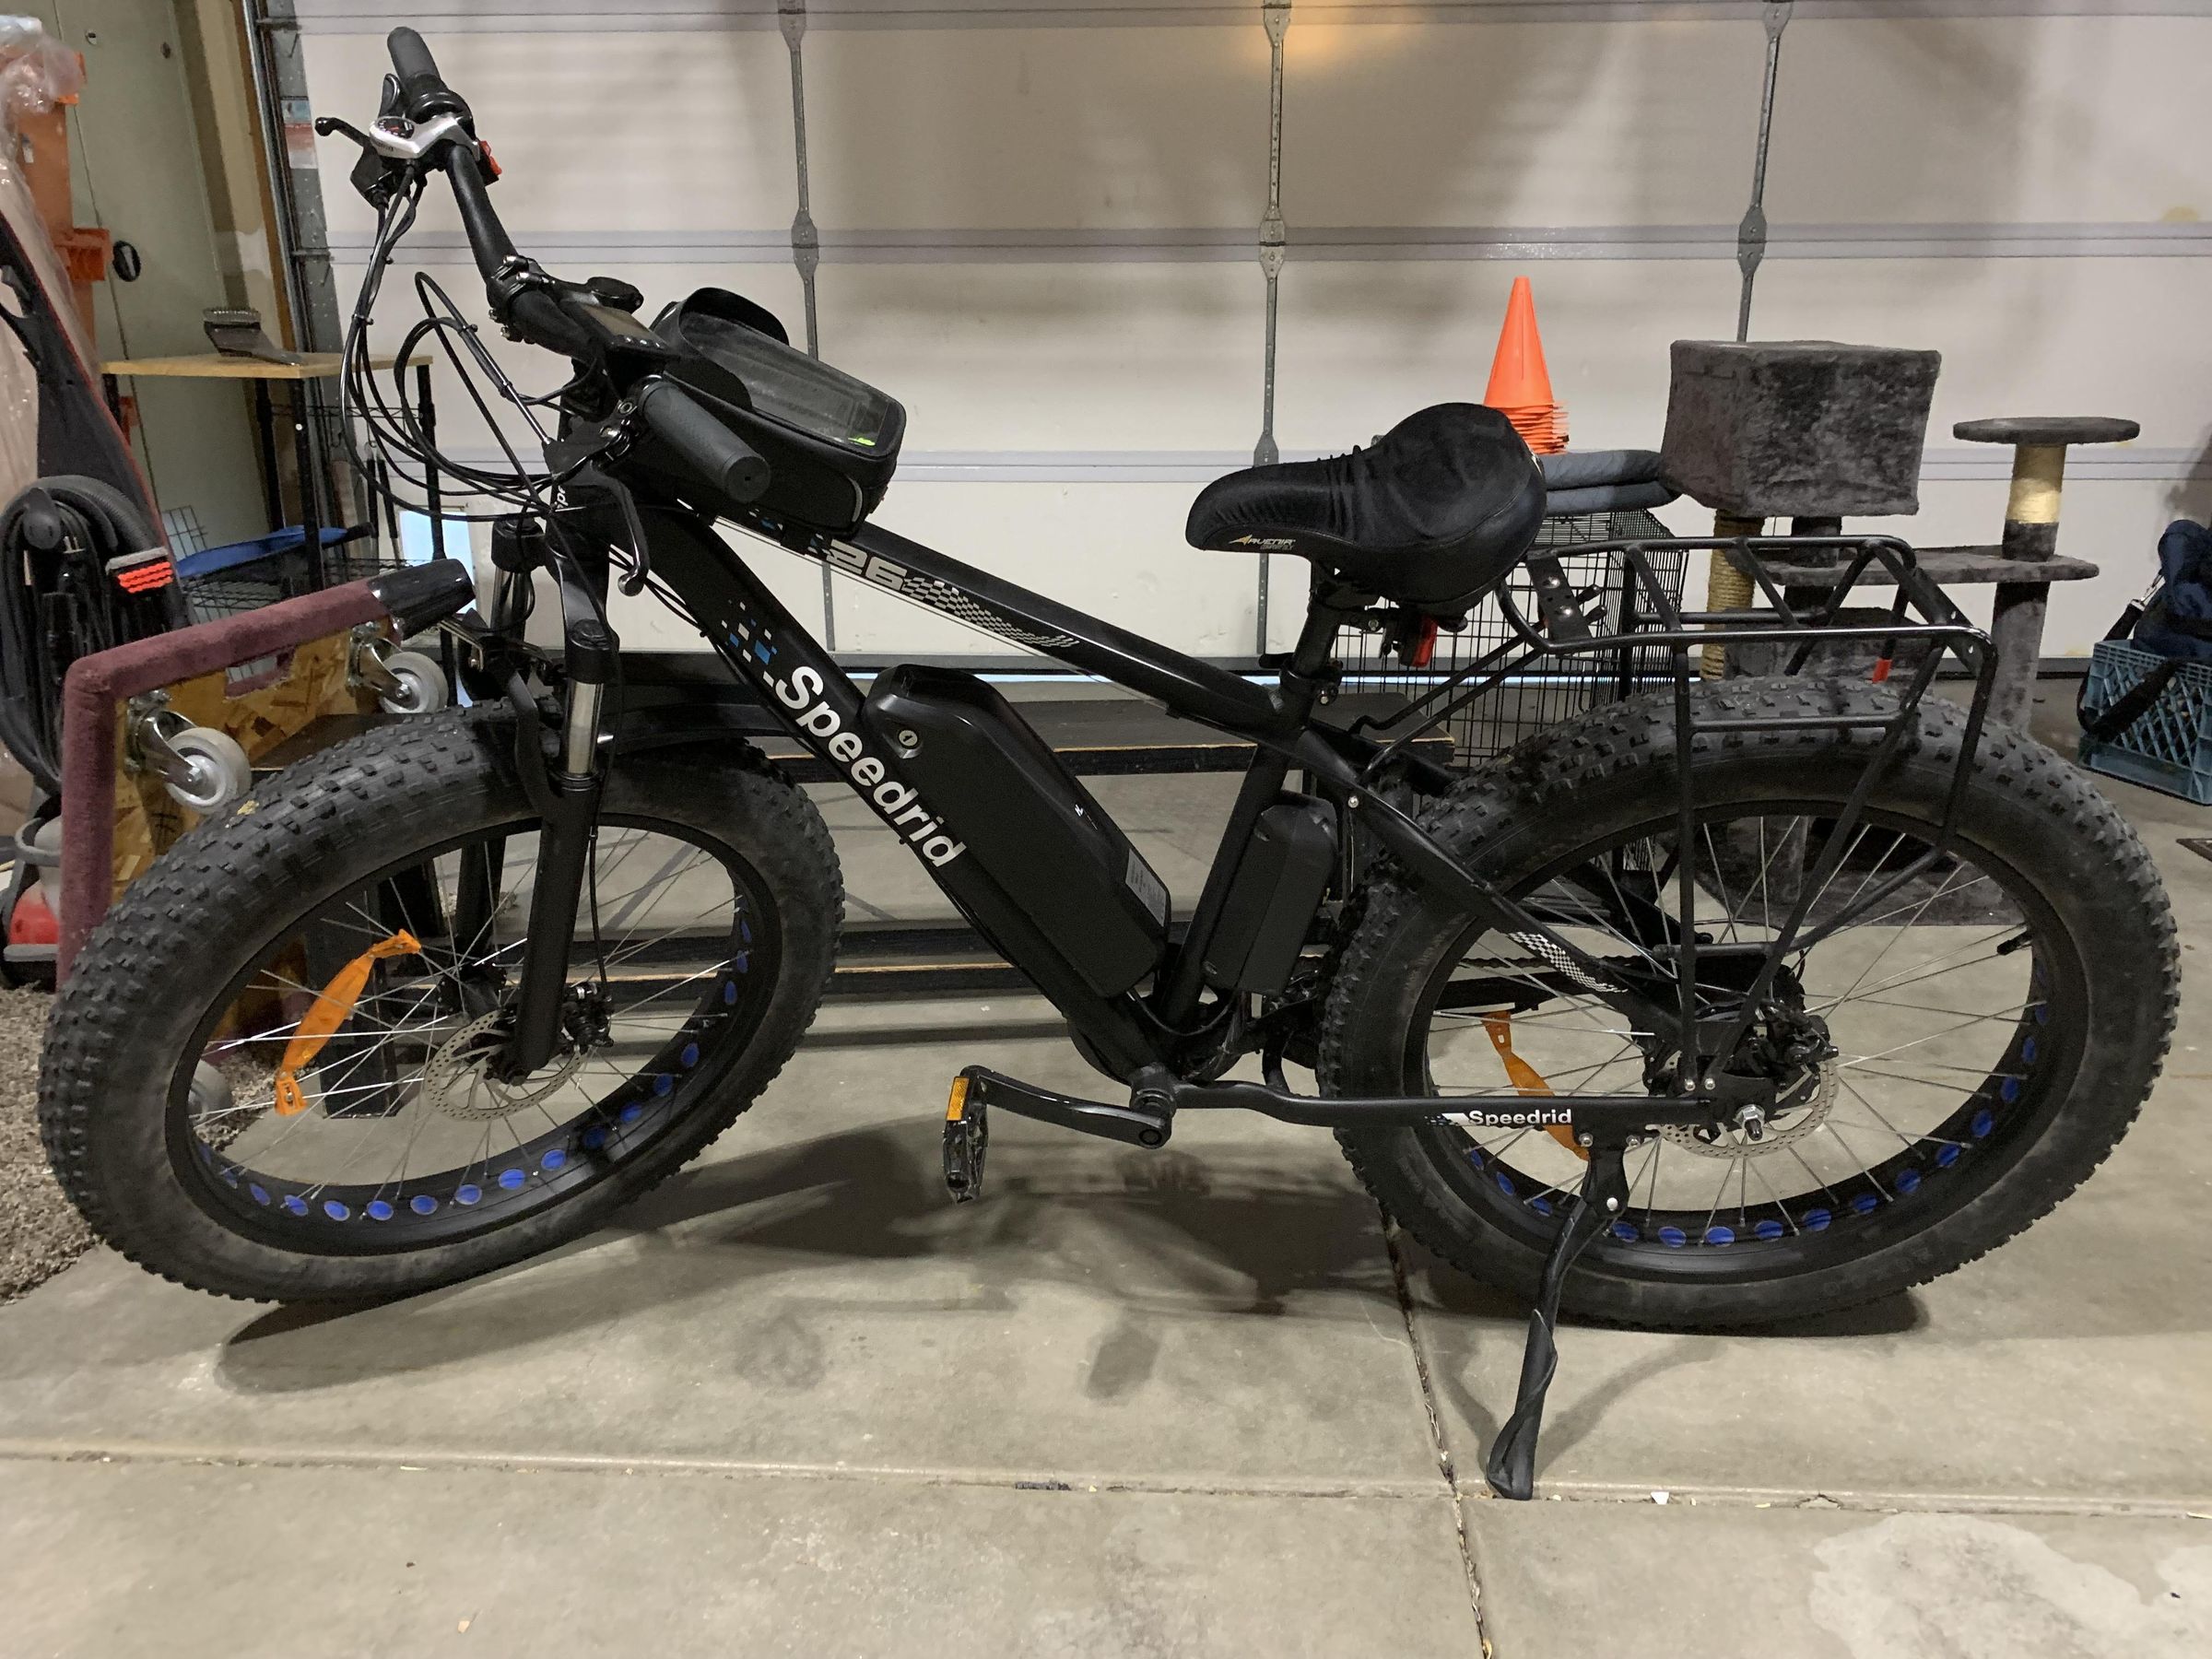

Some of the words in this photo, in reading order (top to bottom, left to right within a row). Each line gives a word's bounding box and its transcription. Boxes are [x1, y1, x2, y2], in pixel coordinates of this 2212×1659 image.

[1247, 537, 1294, 547] AVENIR
[826, 538, 907, 591] 26
[775, 666, 967, 867] Speedrid
[1468, 1109, 1572, 1126] Speedrid
